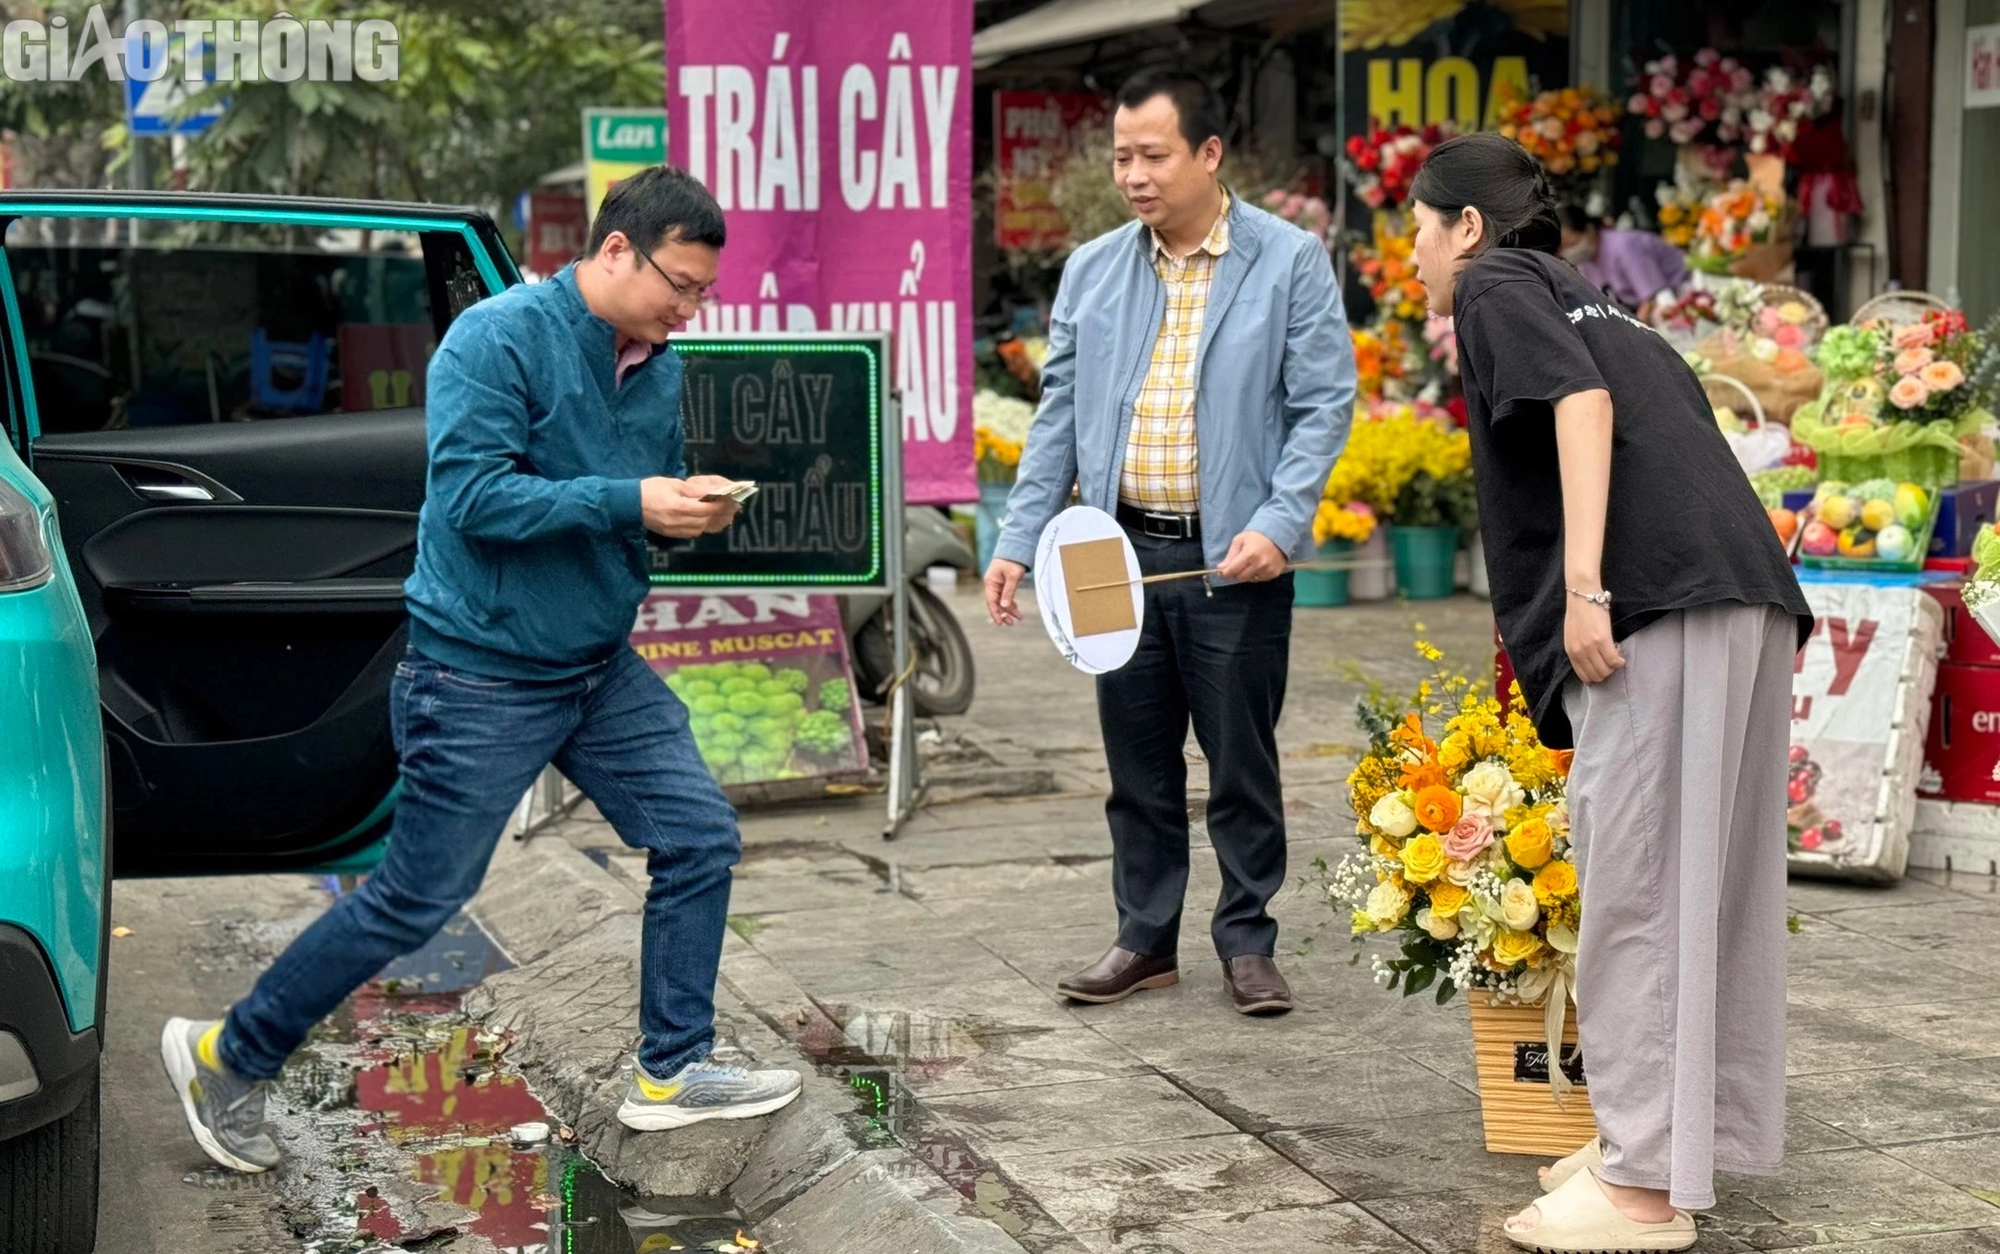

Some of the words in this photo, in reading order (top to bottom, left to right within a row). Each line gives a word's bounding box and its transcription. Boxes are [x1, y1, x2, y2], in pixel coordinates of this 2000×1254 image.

[597, 117, 657, 149] Lan
[679, 32, 820, 211] TRÁI
[838, 32, 959, 212] CÂY
[732, 359, 834, 444] CÂY
[710, 629, 835, 655] MUSCAT
